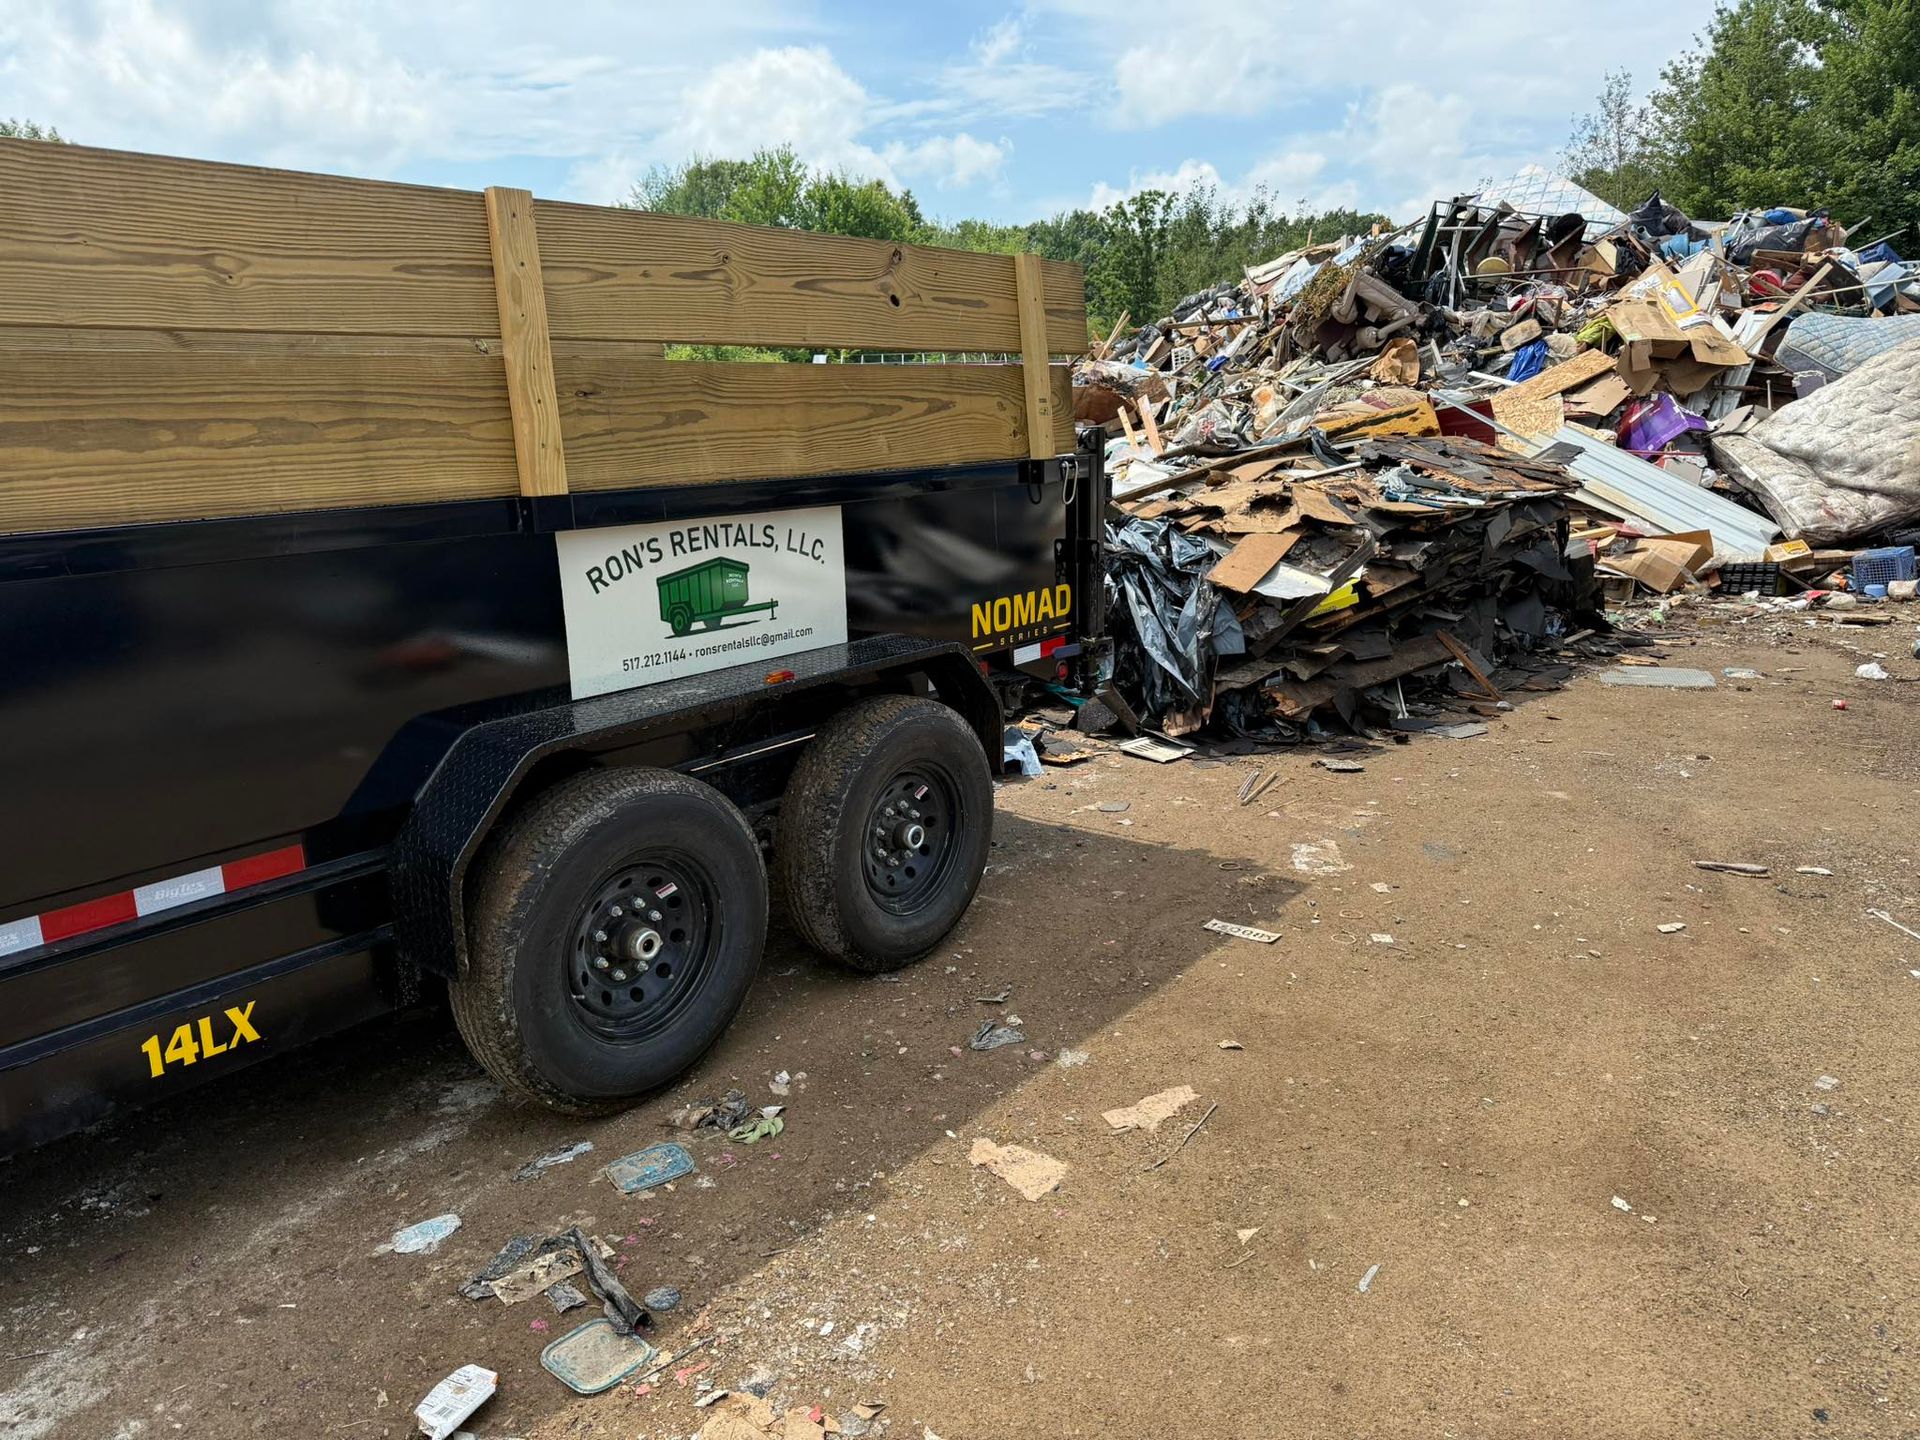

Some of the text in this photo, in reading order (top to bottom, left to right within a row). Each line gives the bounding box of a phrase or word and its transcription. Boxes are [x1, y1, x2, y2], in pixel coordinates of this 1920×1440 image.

[585, 523, 825, 594] RON'S RENTALS, LLC.
[972, 583, 1071, 638] NOMAD
[1000, 626, 1048, 645] SERIES
[622, 626, 814, 672] 517.212.1144 ronsrentalsllc@gmail.com
[141, 1000, 261, 1078] 14LX
